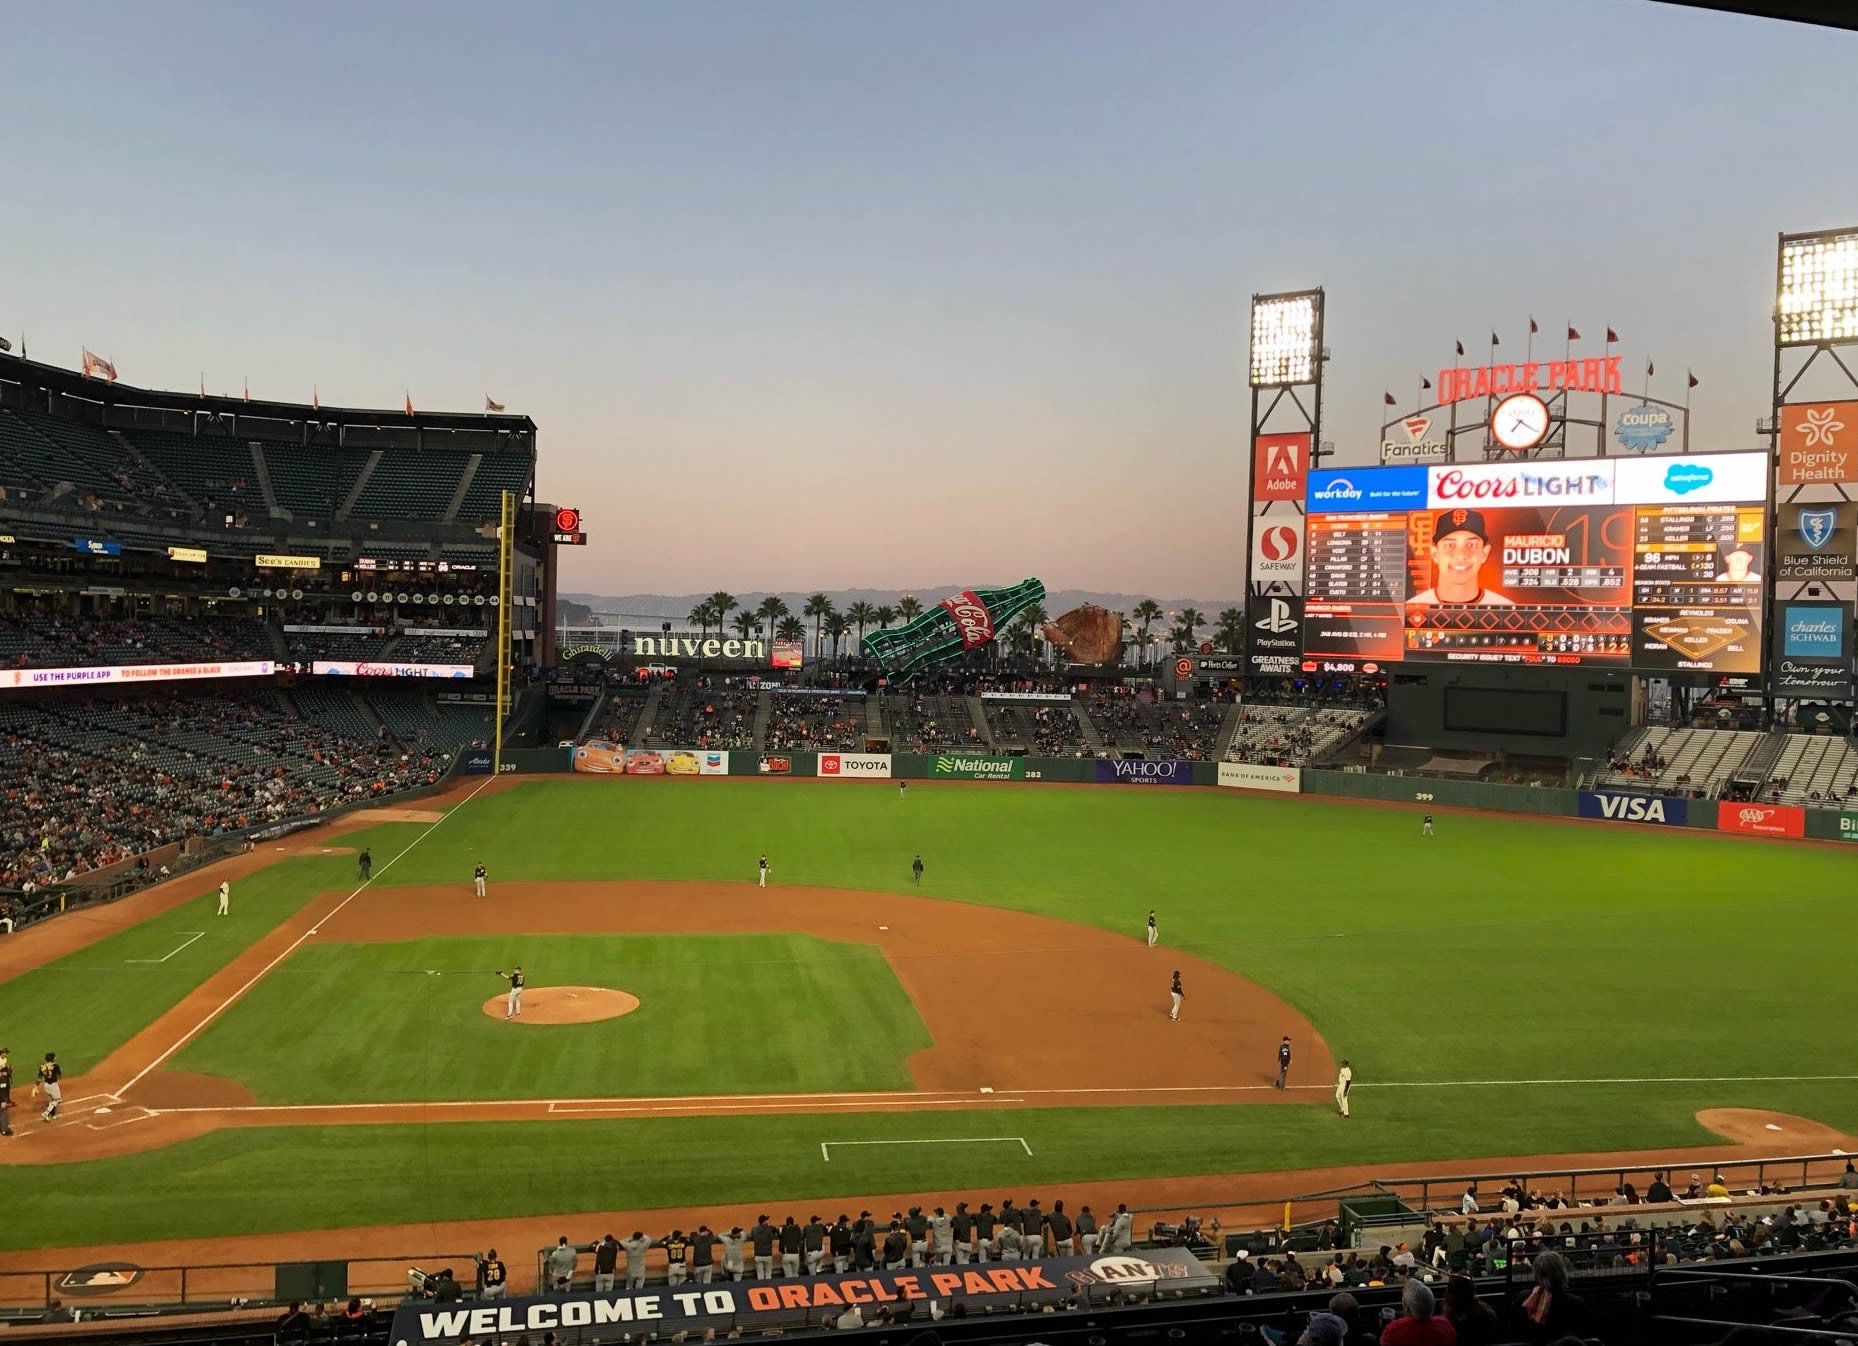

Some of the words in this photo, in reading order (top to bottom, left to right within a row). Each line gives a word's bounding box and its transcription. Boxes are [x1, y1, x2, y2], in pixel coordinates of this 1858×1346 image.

[1437, 362, 1538, 406] ORACLE
[1548, 355, 1622, 395] PARK
[1622, 410, 1667, 427] coupa
[1384, 441, 1448, 457] Fanatics
[1790, 450, 1847, 467] Dignity
[1792, 466, 1844, 481] Health
[1266, 479, 1297, 490] Adobe
[1436, 470, 1519, 499] Coors
[1523, 475, 1599, 497] LIGHT
[1314, 488, 1363, 500] workday
[562, 534, 573, 542] ARE
[1504, 535, 1565, 547] MAURICIO
[257, 556, 282, 566] See's
[284, 559, 316, 568] CANDIES
[1503, 547, 1570, 565] DUBON
[1784, 555, 1809, 566] Blue
[1812, 555, 1848, 565] Shield
[1260, 562, 1297, 571] SAFEWAY
[1567, 568, 1573, 576] 2
[1656, 563, 1687, 571] FASTBALL
[1780, 567, 1791, 577] of
[1793, 566, 1852, 577] California
[1520, 578, 1539, 586] .324
[1791, 620, 1837, 633] charles
[1256, 638, 1294, 647] PlayStation
[1560, 634, 1567, 642] 0
[1573, 634, 1580, 643] 0
[1790, 633, 1837, 642] SCHWAB
[562, 644, 614, 661] Ghirardelli
[634, 636, 765, 659] nuveen
[1598, 643, 1605, 653] 1
[1609, 643, 1617, 653] 2
[1620, 643, 1629, 653] 2
[1250, 655, 1299, 666] GREATNESS
[1546, 655, 1557, 663] TO
[355, 662, 395, 677] Coors
[1176, 658, 1192, 675] @
[1221, 661, 1238, 670] Coffee
[1259, 663, 1292, 673] AWAITS
[1323, 662, 1355, 672] $4,800
[1780, 661, 1810, 674] Own
[1811, 666, 1846, 680] your
[33, 672, 49, 682] USE
[50, 671, 66, 681] THE
[66, 670, 95, 681] PURPLE
[96, 670, 111, 679] APP
[121, 669, 131, 677] TO
[131, 668, 158, 677] FOLLOW
[159, 667, 171, 676] THE
[172, 667, 197, 675] ORANGE
[202, 666, 221, 674] BLACK
[1779, 674, 1847, 686] tomorrow
[500, 763, 516, 772] 339
[844, 760, 888, 771] TOYOTA
[953, 757, 1013, 773] National
[1111, 760, 1178, 778] YAHOO!
[1221, 771, 1240, 779] BANK
[1250, 773, 1281, 782] AMERICA
[1416, 792, 1434, 801] 399
[1594, 794, 1666, 823] VISA
[1742, 810, 1763, 822] AAA
[1752, 824, 1786, 832] Insurance
[1840, 817, 1858, 831] Bi
[419, 1295, 663, 1339] WELCOME
[673, 1289, 736, 1316] TO
[747, 1277, 927, 1312] ORACLE
[930, 1265, 1056, 1295] PARK
